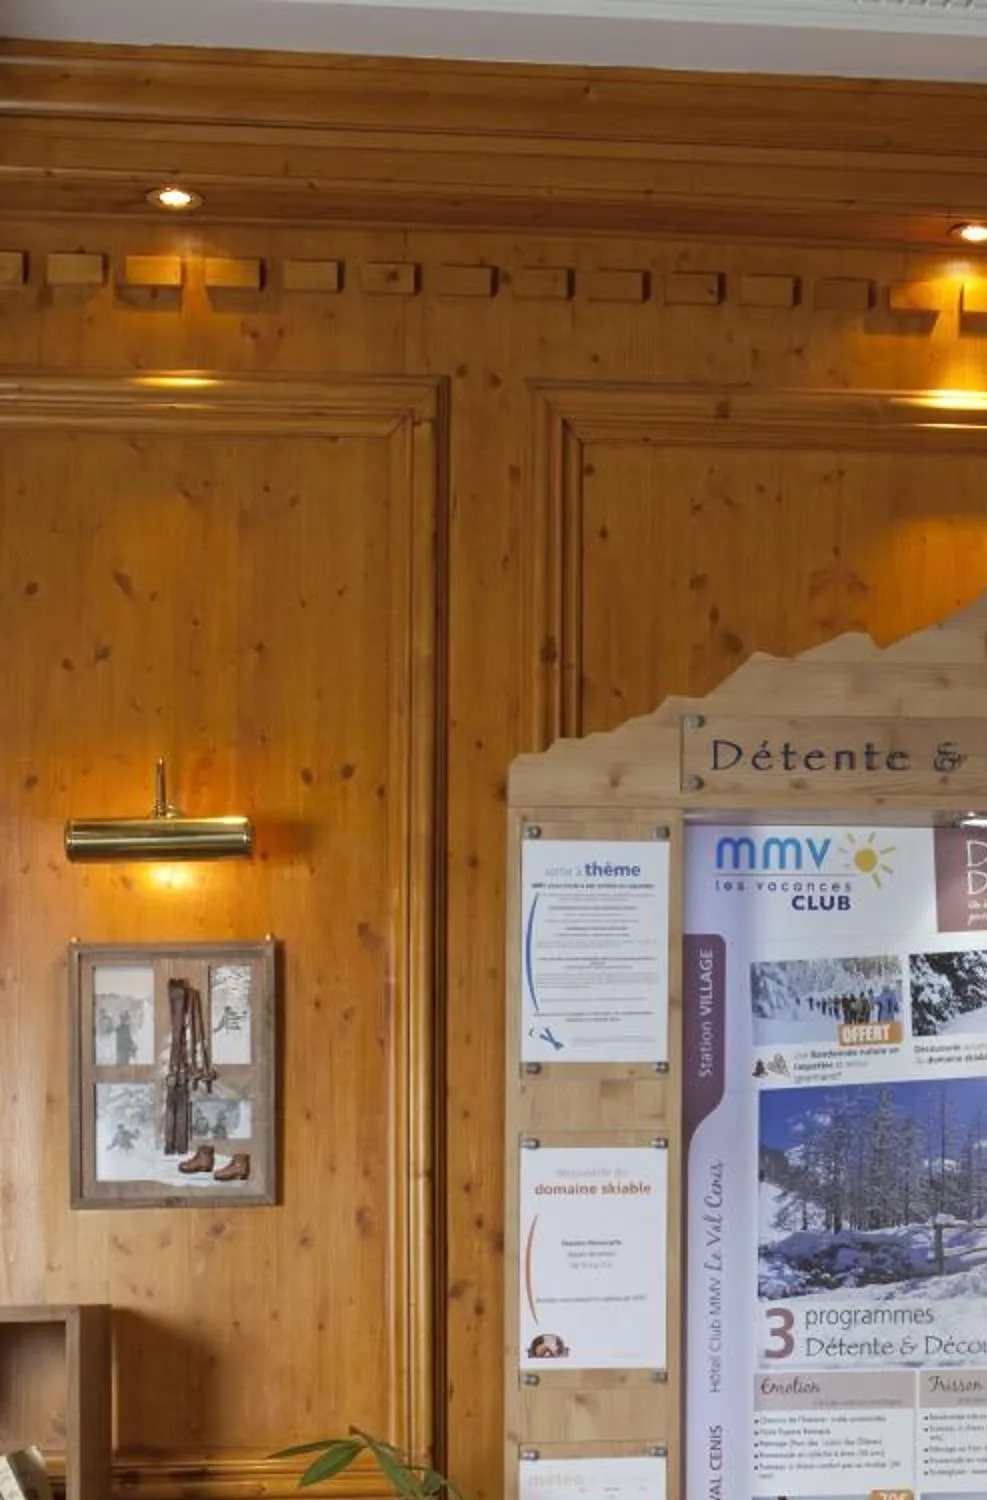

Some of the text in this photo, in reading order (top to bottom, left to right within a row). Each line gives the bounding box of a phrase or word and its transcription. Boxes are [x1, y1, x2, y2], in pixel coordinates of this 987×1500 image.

[711, 739, 911, 772] Détente
[933, 741, 967, 773] &
[715, 836, 832, 869] mmv
[584, 861, 641, 877] thème
[715, 879, 852, 892] les vacances
[791, 895, 851, 911] CLUB
[699, 948, 714, 1078] Station VILLAGE
[841, 1024, 890, 1042] OFFERT
[534, 1181, 652, 1196] domaine skiable
[704, 1213, 722, 1247] Val
[704, 1250, 722, 1272] Le
[709, 1278, 722, 1316] MMV
[805, 1306, 935, 1330] programmes
[708, 1319, 722, 1352] Club
[764, 1307, 795, 1359] 3
[805, 1337, 894, 1358] Détente
[901, 1337, 918, 1352] &
[928, 1374, 985, 1394] Frisson
[709, 1424, 723, 1471] CENIS
